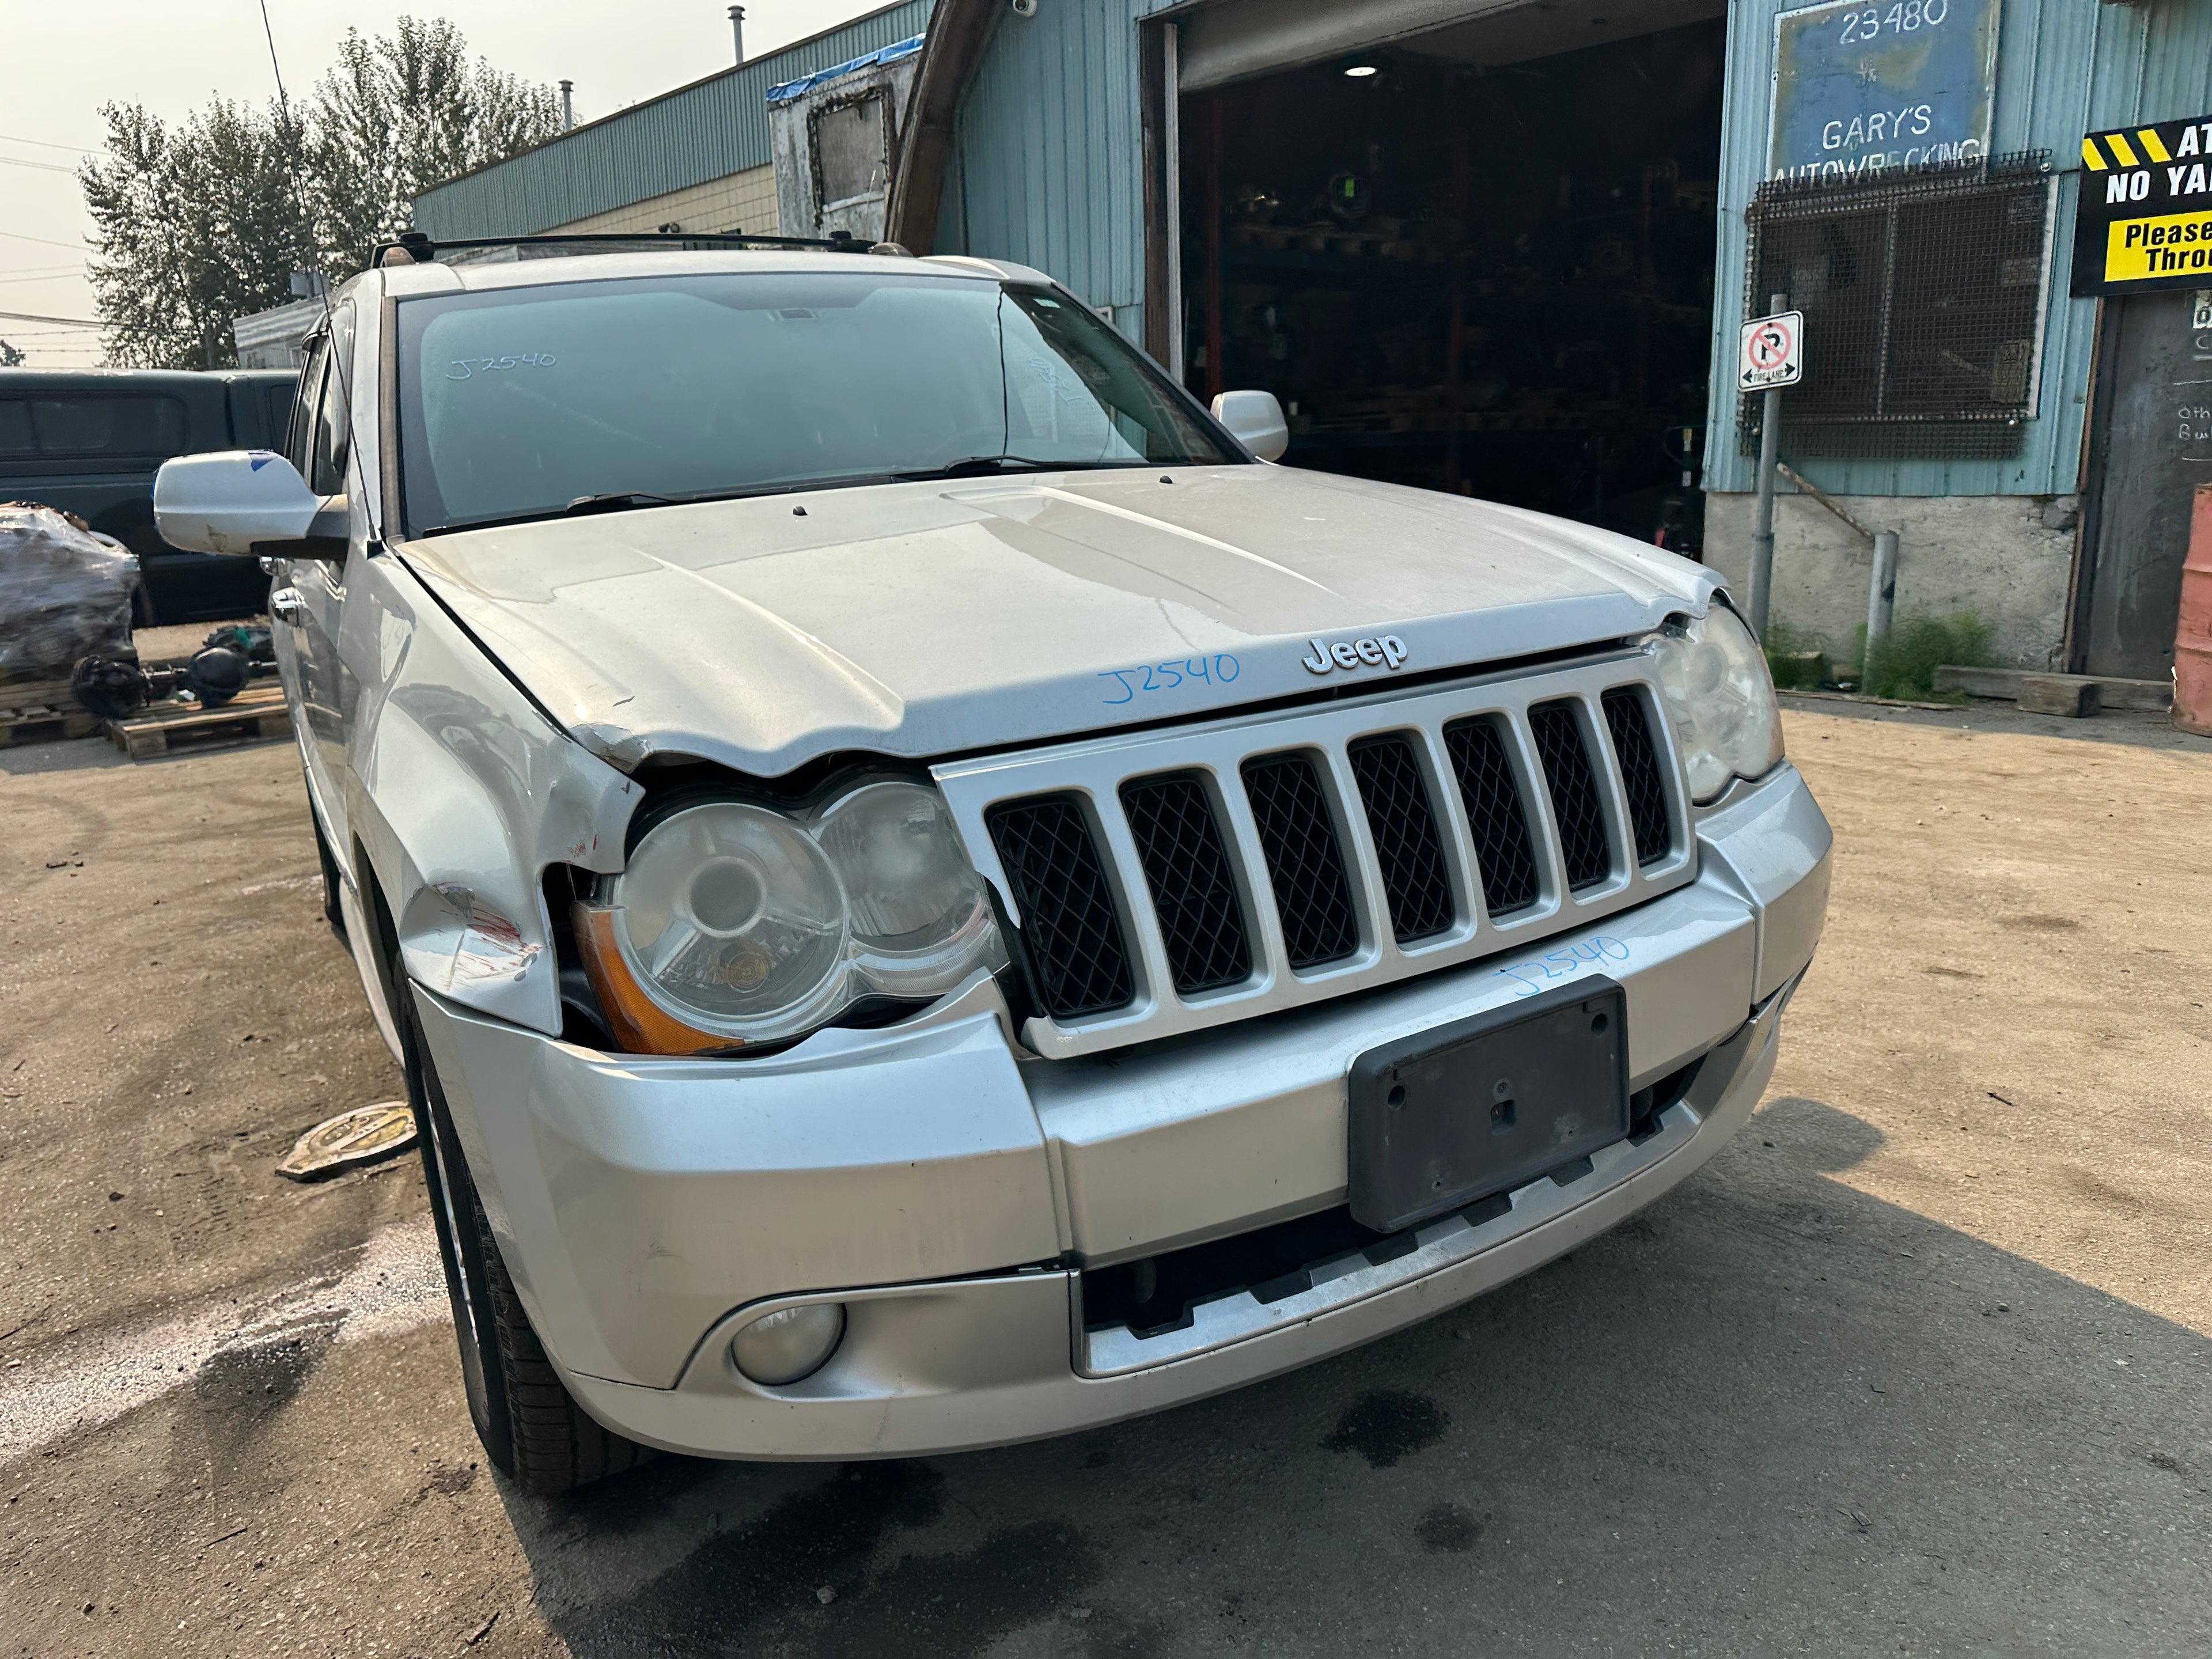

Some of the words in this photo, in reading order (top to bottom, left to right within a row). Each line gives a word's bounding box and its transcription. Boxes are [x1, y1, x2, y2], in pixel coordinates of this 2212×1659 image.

[1840, 0, 1947, 44] 23480
[1823, 104, 1931, 150] GARY'S
[2106, 171, 2150, 204] NO
[2167, 164, 2212, 196] YA
[2125, 221, 2212, 248] Please
[2145, 248, 2212, 272] Thro
[446, 353, 556, 380] J2540
[1754, 373, 1766, 382] FIRE
[1302, 634, 1407, 675] Jeep
[1097, 654, 1240, 704] J2540
[1492, 936, 1630, 997] J2540
